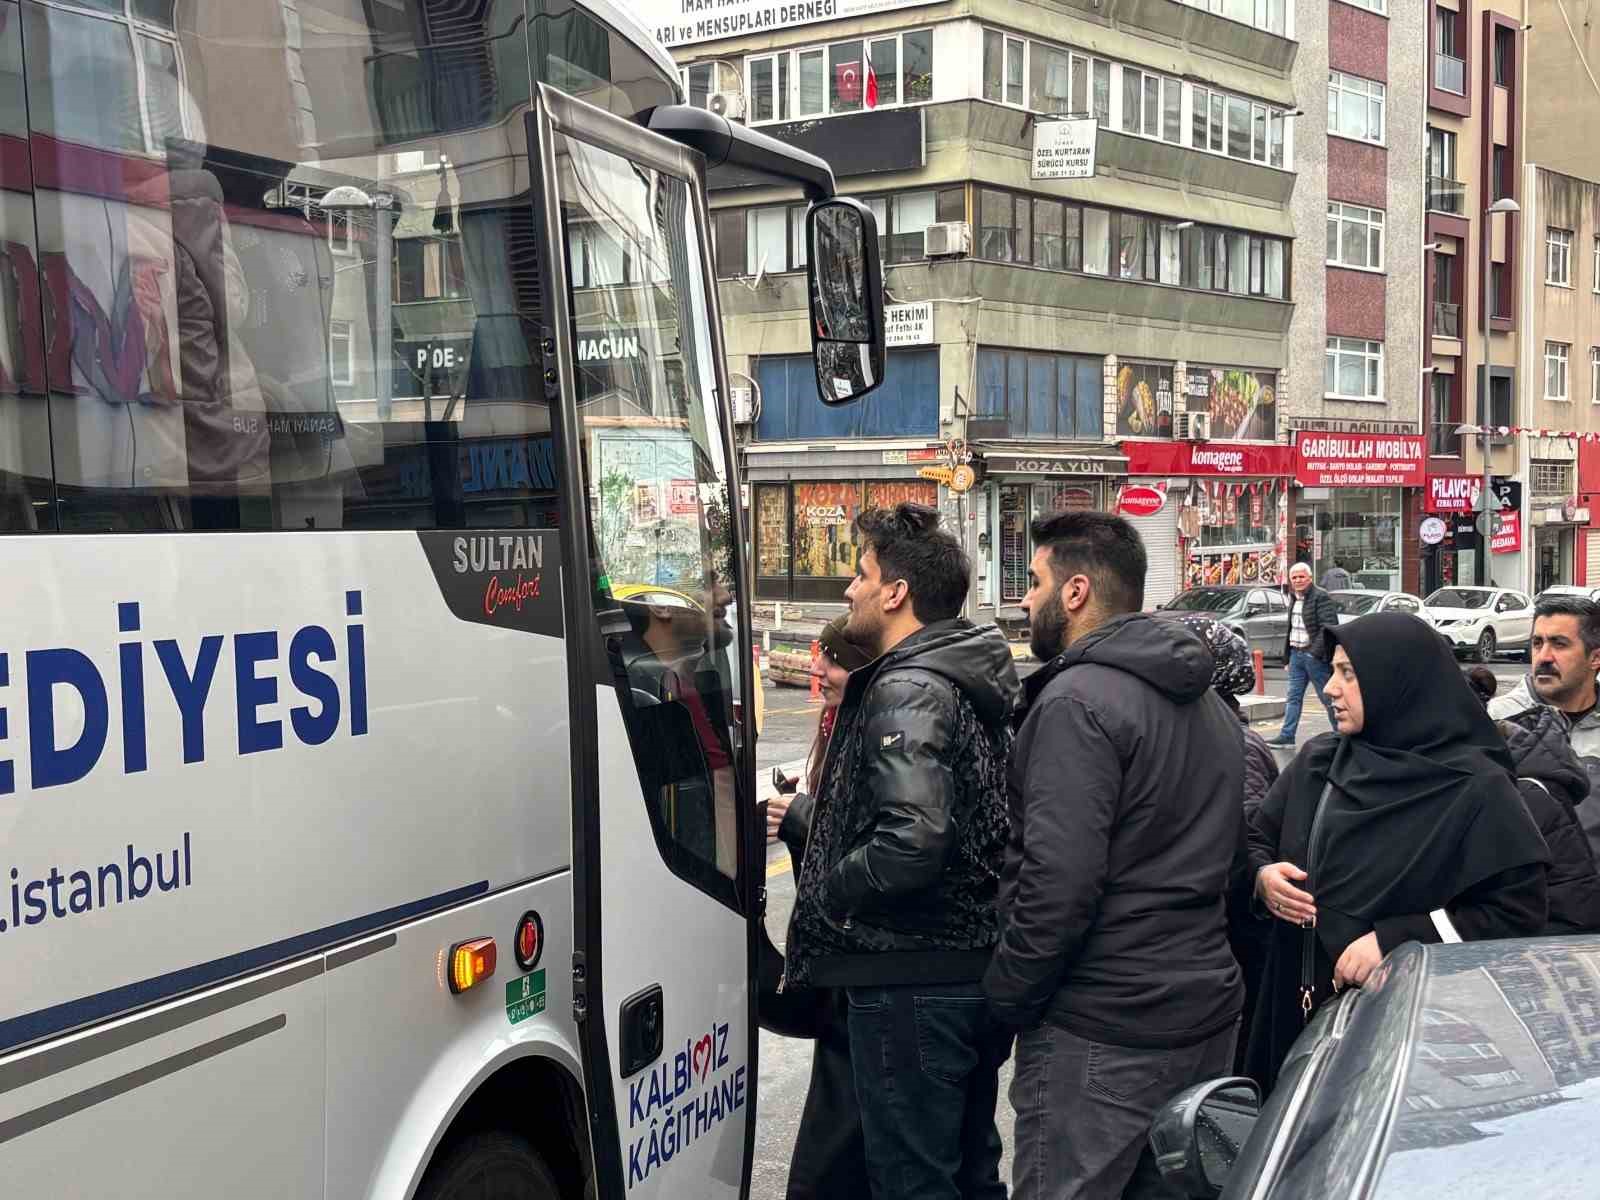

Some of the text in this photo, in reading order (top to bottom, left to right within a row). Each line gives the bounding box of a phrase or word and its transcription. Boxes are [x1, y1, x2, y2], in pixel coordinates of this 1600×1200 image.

[680, 26, 693, 40] ve
[697, 8, 776, 37] MENSUPLARI
[1055, 147, 1091, 157] KURTARAN
[1066, 158, 1089, 167] KURSU
[417, 344, 454, 369] PDE
[1191, 446, 1243, 471] komagene
[1301, 434, 1422, 459] GARİBULLAH MOBİLYA
[1015, 460, 1105, 473] KOZA YÜN
[806, 505, 846, 517] KOZA
[453, 536, 542, 573] SULTAN
[485, 573, 541, 615] Comfort
[629, 1065, 745, 1189] KÂĞITHANE
